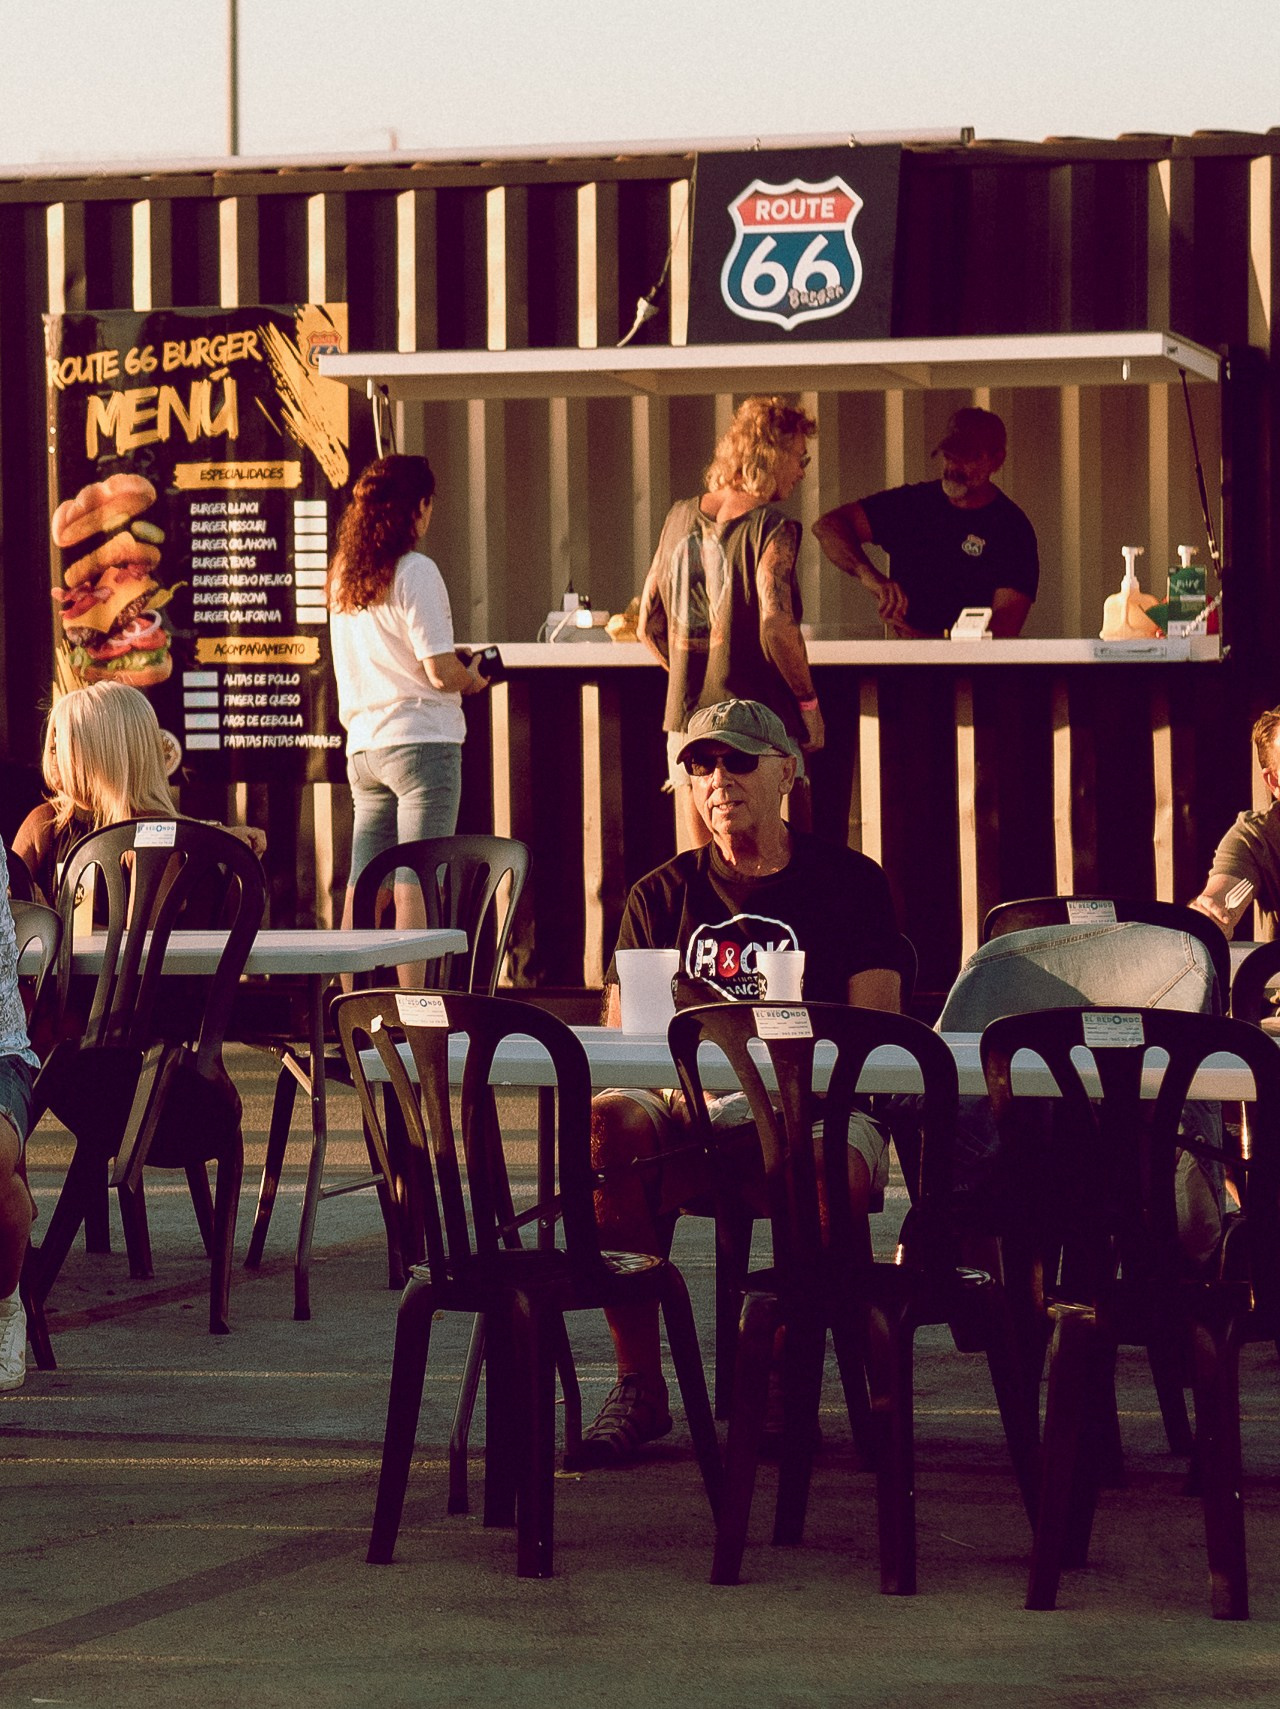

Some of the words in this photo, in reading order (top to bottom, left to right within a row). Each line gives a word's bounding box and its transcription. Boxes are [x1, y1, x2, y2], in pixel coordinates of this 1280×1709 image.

[755, 197, 836, 221] ROUTE
[741, 234, 841, 308] 66
[48, 350, 119, 390] ROUTE
[125, 345, 158, 374] 66
[162, 330, 262, 372] BURGER
[86, 367, 238, 460] MENÚ
[200, 468, 284, 481] ESPECIALIDADES
[190, 502, 227, 516] BURGER
[191, 520, 228, 534] BURGER
[191, 538, 228, 551] BURGER
[228, 537, 277, 551] OKLAHOMA
[192, 556, 228, 569] BURGER
[229, 556, 256, 568] TEXAS
[192, 574, 229, 587] BURGER
[229, 574, 258, 587] NUEVO
[259, 574, 293, 587] MEJICO
[193, 592, 229, 605] BURGER
[230, 592, 267, 605] ARIZONA
[193, 610, 230, 623] BURGER
[230, 609, 281, 623] CALIFORNIA
[214, 642, 305, 655] ACOMPAÑAMIENTO
[224, 673, 252, 687] ALITAS
[254, 673, 266, 686] DE
[268, 673, 300, 687] POLLO
[224, 694, 255, 708] FINGER
[255, 694, 267, 707] DE
[269, 694, 301, 708] QUESO
[223, 714, 245, 728] AROS
[247, 715, 259, 727] DE
[260, 714, 303, 728] CEBOLLA
[224, 735, 262, 748] PATATAS
[263, 735, 293, 748] FRITAS
[694, 938, 791, 977] ROC
[767, 1009, 807, 1019] REDONDO
